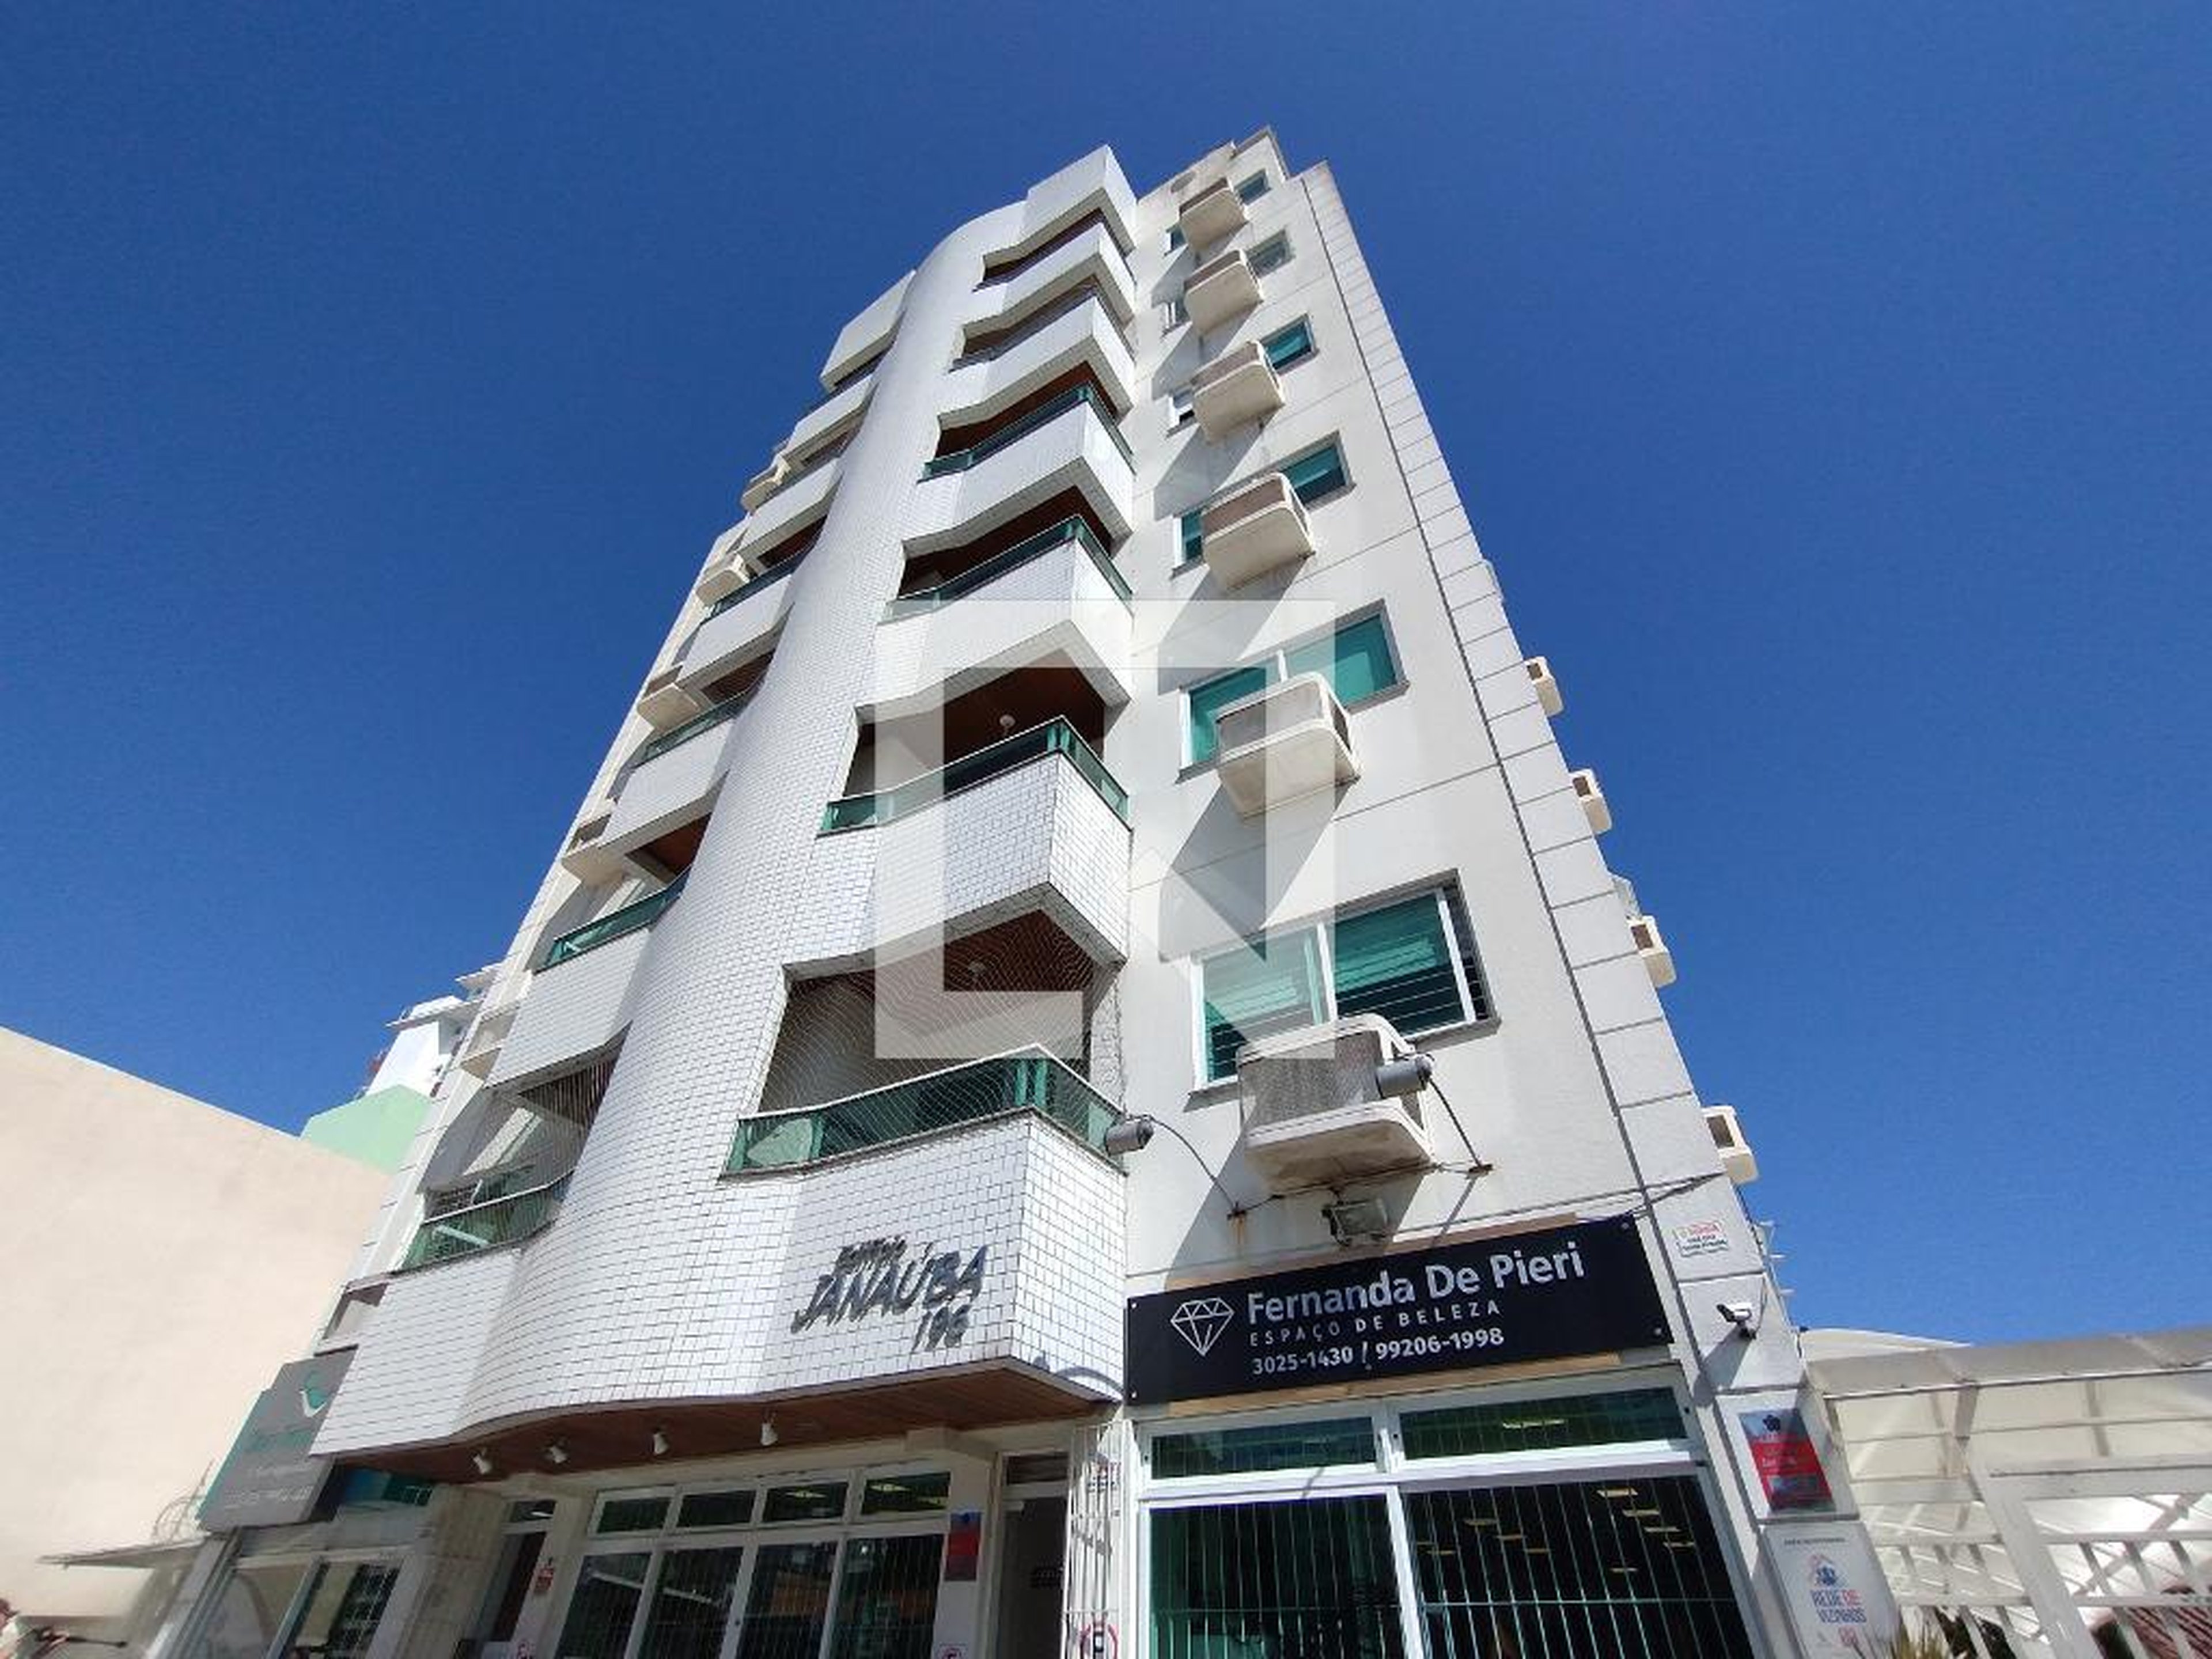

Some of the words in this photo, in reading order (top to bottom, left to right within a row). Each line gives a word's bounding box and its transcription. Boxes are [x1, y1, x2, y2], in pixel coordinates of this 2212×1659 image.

[1248, 1269, 1416, 1324] Fernanda
[1425, 1264, 1480, 1298] De
[1490, 1241, 1585, 1288] Pieri
[1249, 1323, 1341, 1346] ESPAÇO
[1355, 1316, 1383, 1332] DE
[1399, 1300, 1499, 1326] BELEZA
[1252, 1345, 1354, 1375] 3025-1430
[1375, 1327, 1505, 1360] 99206-1998
